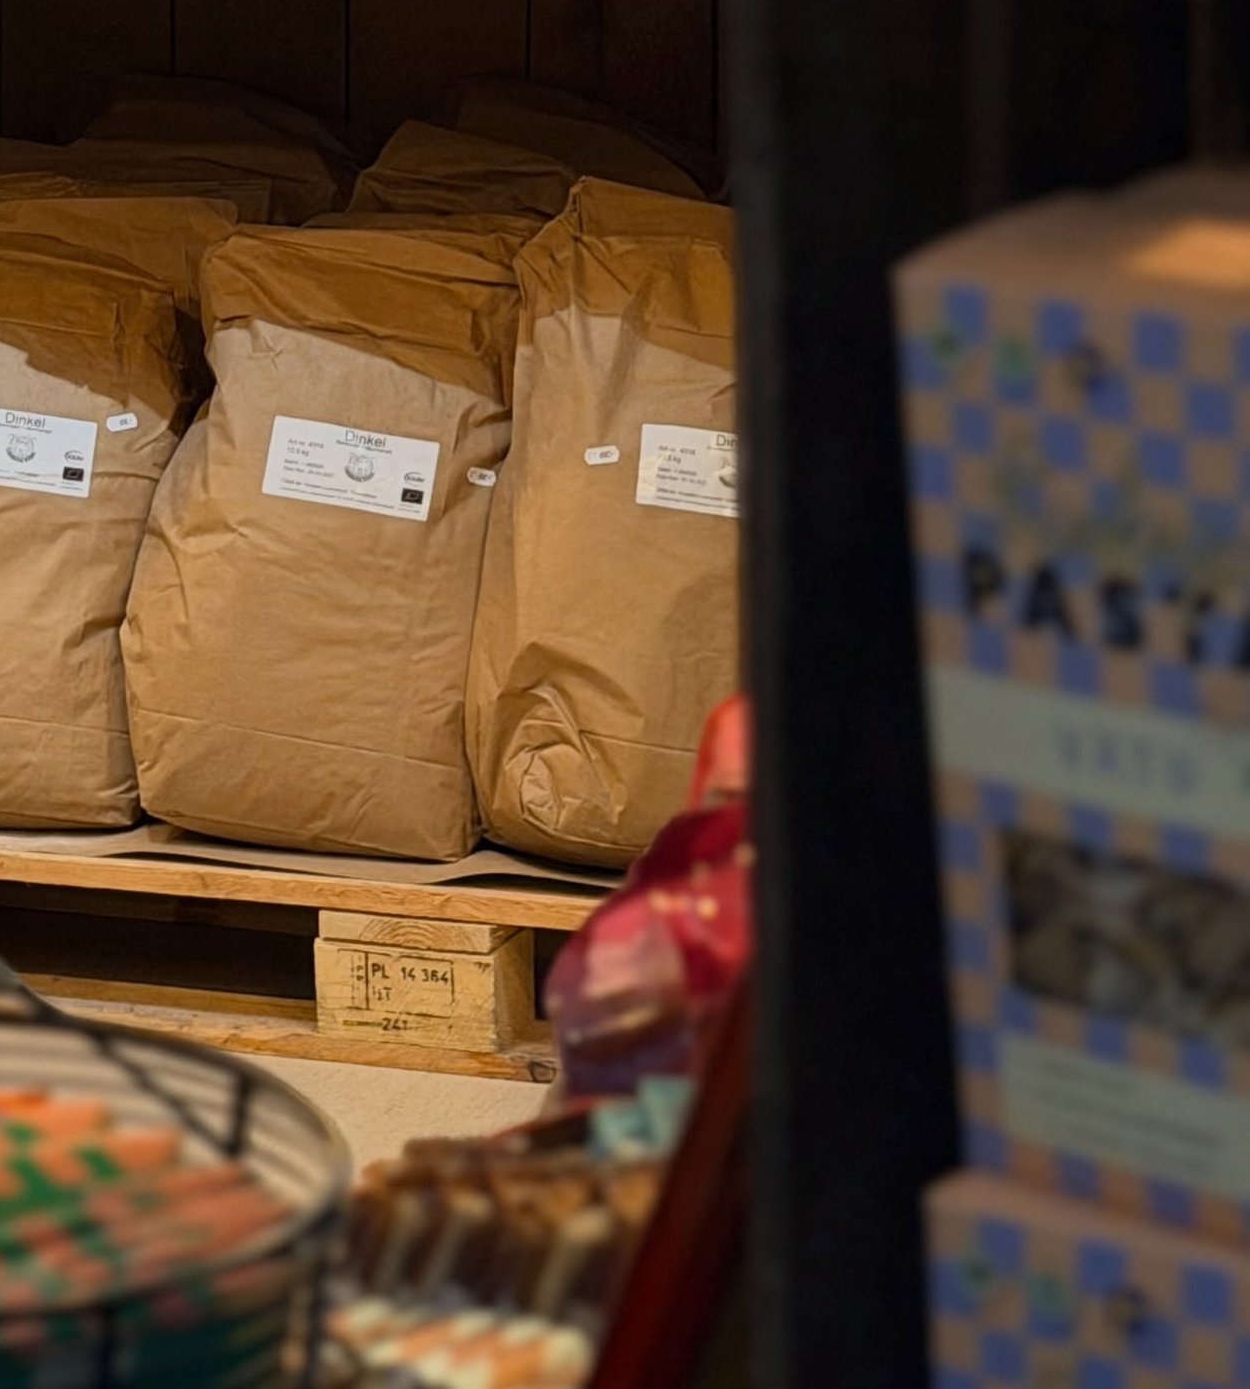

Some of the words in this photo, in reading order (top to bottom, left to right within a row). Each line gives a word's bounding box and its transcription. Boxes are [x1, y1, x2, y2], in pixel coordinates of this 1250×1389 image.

[4, 411, 47, 429] Dinkel
[345, 430, 387, 448] Dinkel
[716, 434, 737, 447] Din
[371, 962, 390, 979] PL
